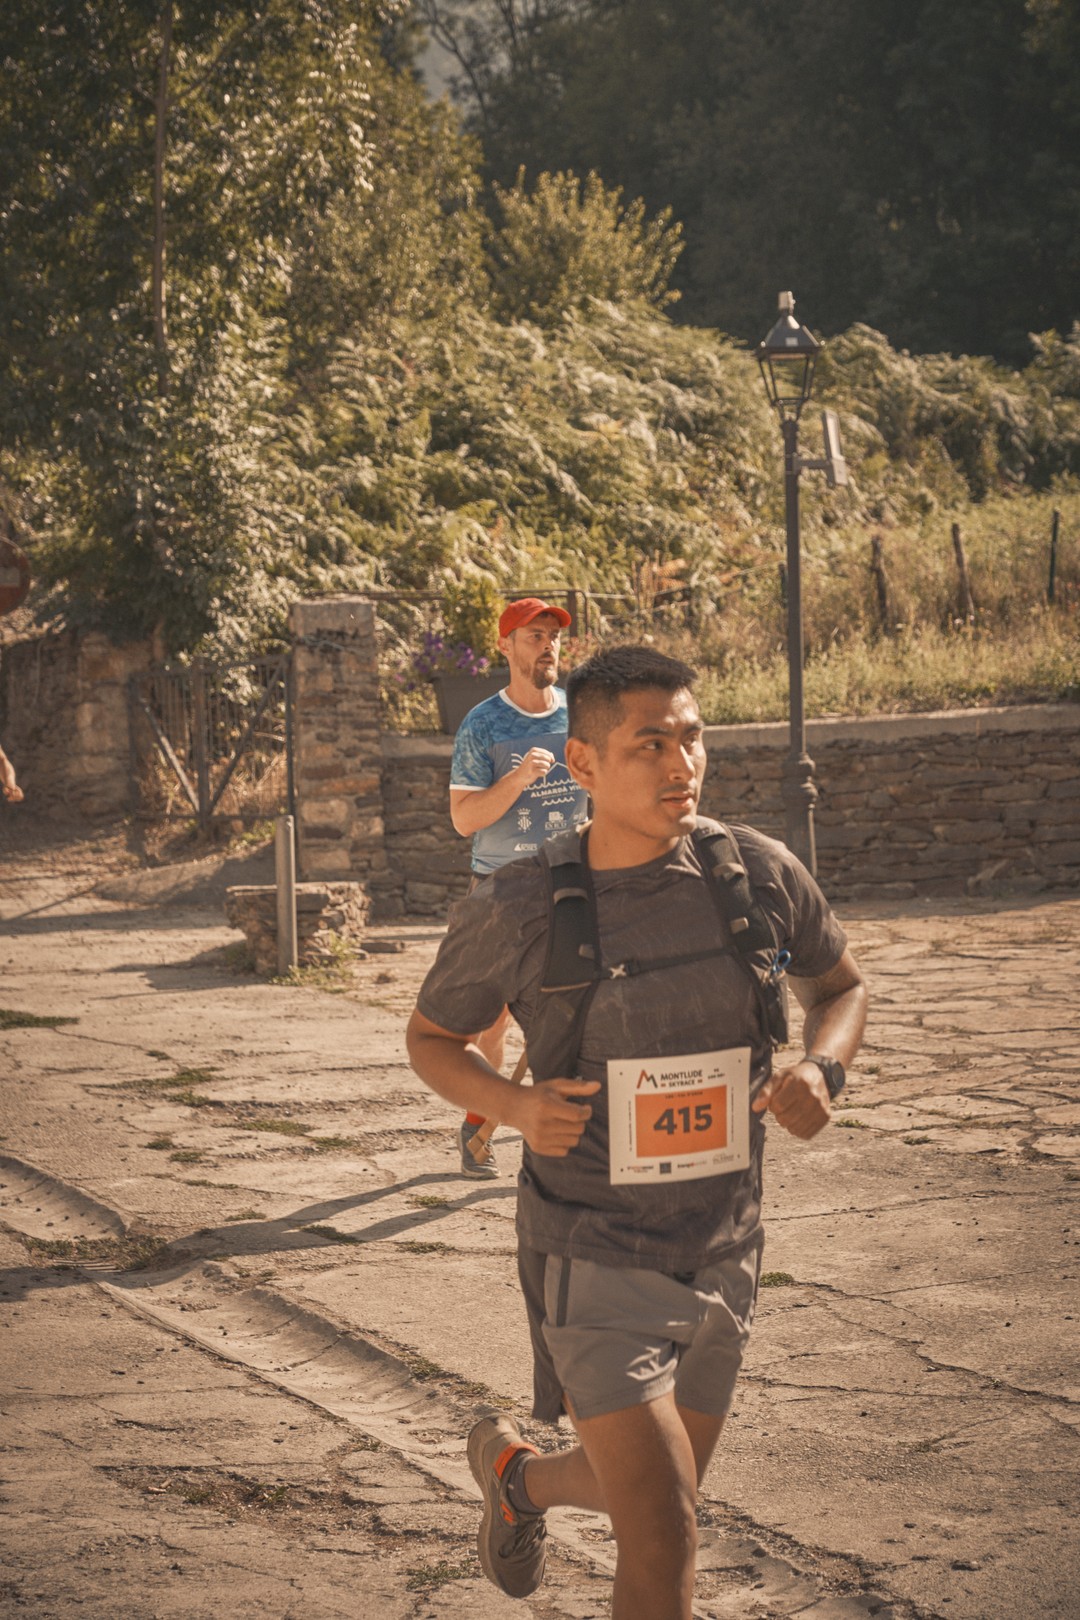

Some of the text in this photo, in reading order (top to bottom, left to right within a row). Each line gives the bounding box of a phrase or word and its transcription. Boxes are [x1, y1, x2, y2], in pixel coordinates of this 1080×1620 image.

[660, 1069, 703, 1081] MONTLUDE
[668, 1079, 696, 1088] SKYRACE
[653, 1104, 713, 1135] 415
